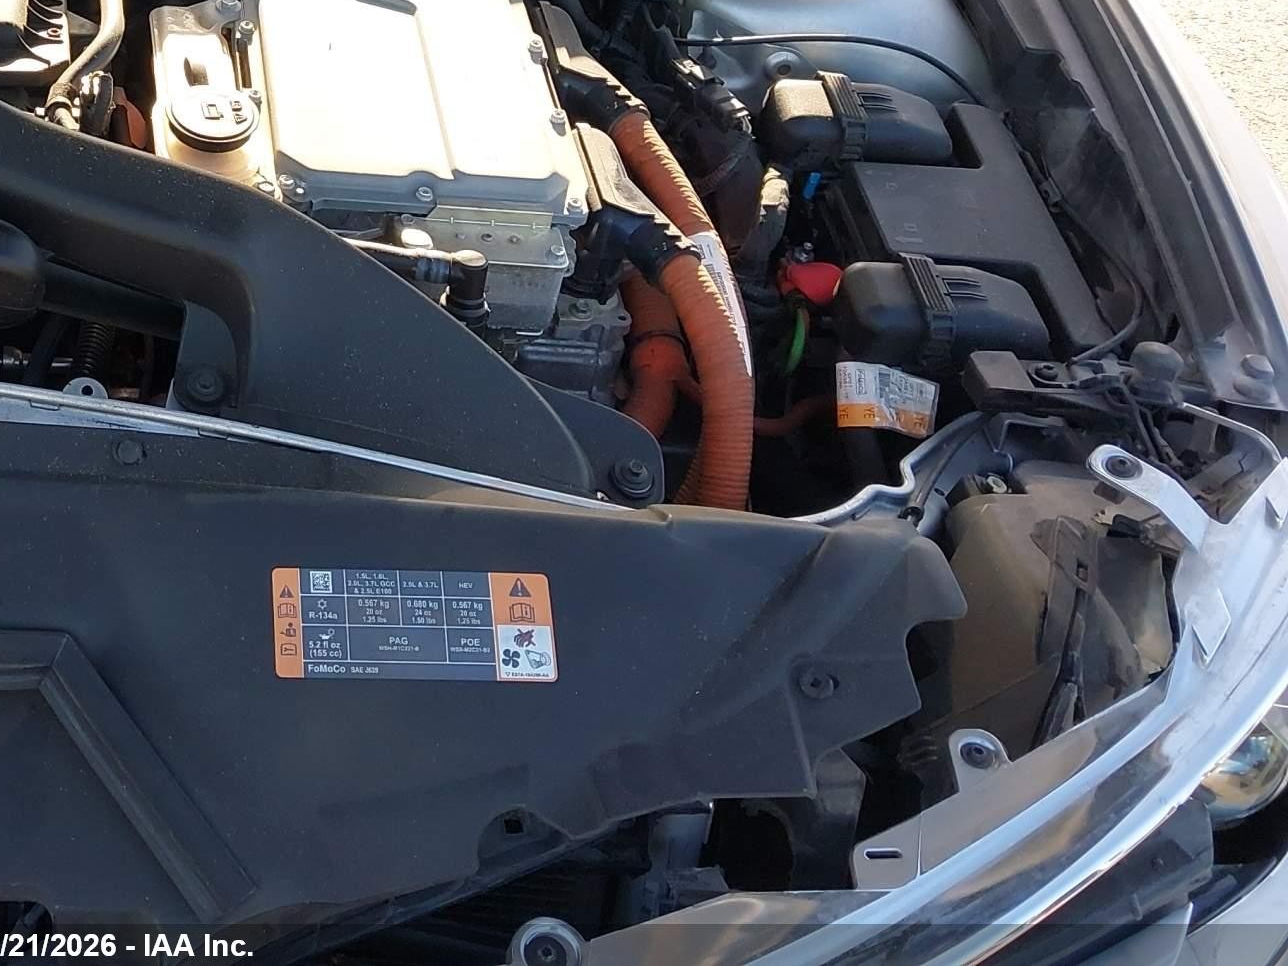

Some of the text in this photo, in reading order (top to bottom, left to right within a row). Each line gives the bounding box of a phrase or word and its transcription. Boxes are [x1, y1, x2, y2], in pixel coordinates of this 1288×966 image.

[380, 600, 389, 609] kg
[429, 601, 438, 610] kg
[474, 602, 483, 611] kg
[309, 612, 338, 620] R-134a
[389, 636, 408, 645] PAG
[461, 638, 480, 646] POE
[309, 649, 342, 658] (155 cc)
[308, 664, 345, 673] FoMoCo
